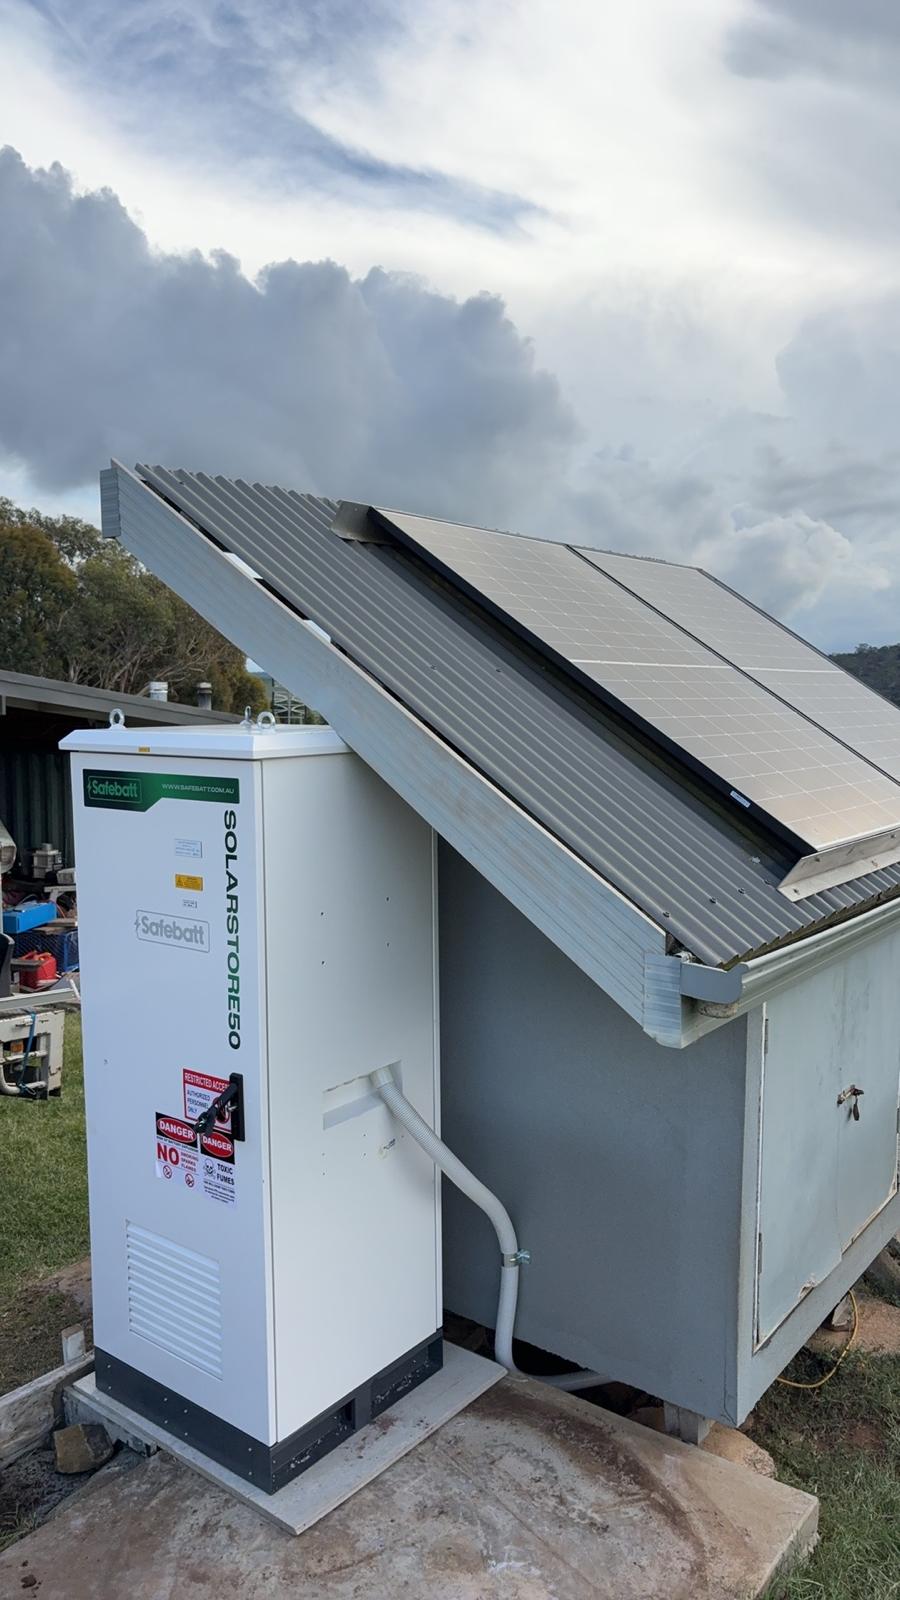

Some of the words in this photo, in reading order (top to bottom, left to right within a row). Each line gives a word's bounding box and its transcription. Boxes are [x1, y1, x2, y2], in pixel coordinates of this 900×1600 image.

[91, 780, 139, 798] Safebatt
[161, 783, 235, 794] WWW.SAFEBATT.COM.AU
[141, 916, 205, 945] Safebatt
[224, 809, 241, 1050] SOLARSTORE50
[184, 1072, 213, 1088] RESTRICTED
[212, 1080, 229, 1092] ACCES
[159, 1120, 195, 1140] DANGER
[202, 1135, 232, 1152] DANGER
[157, 1142, 180, 1165] NO
[217, 1163, 233, 1175] TOXIC
[216, 1173, 235, 1186] FUMES
